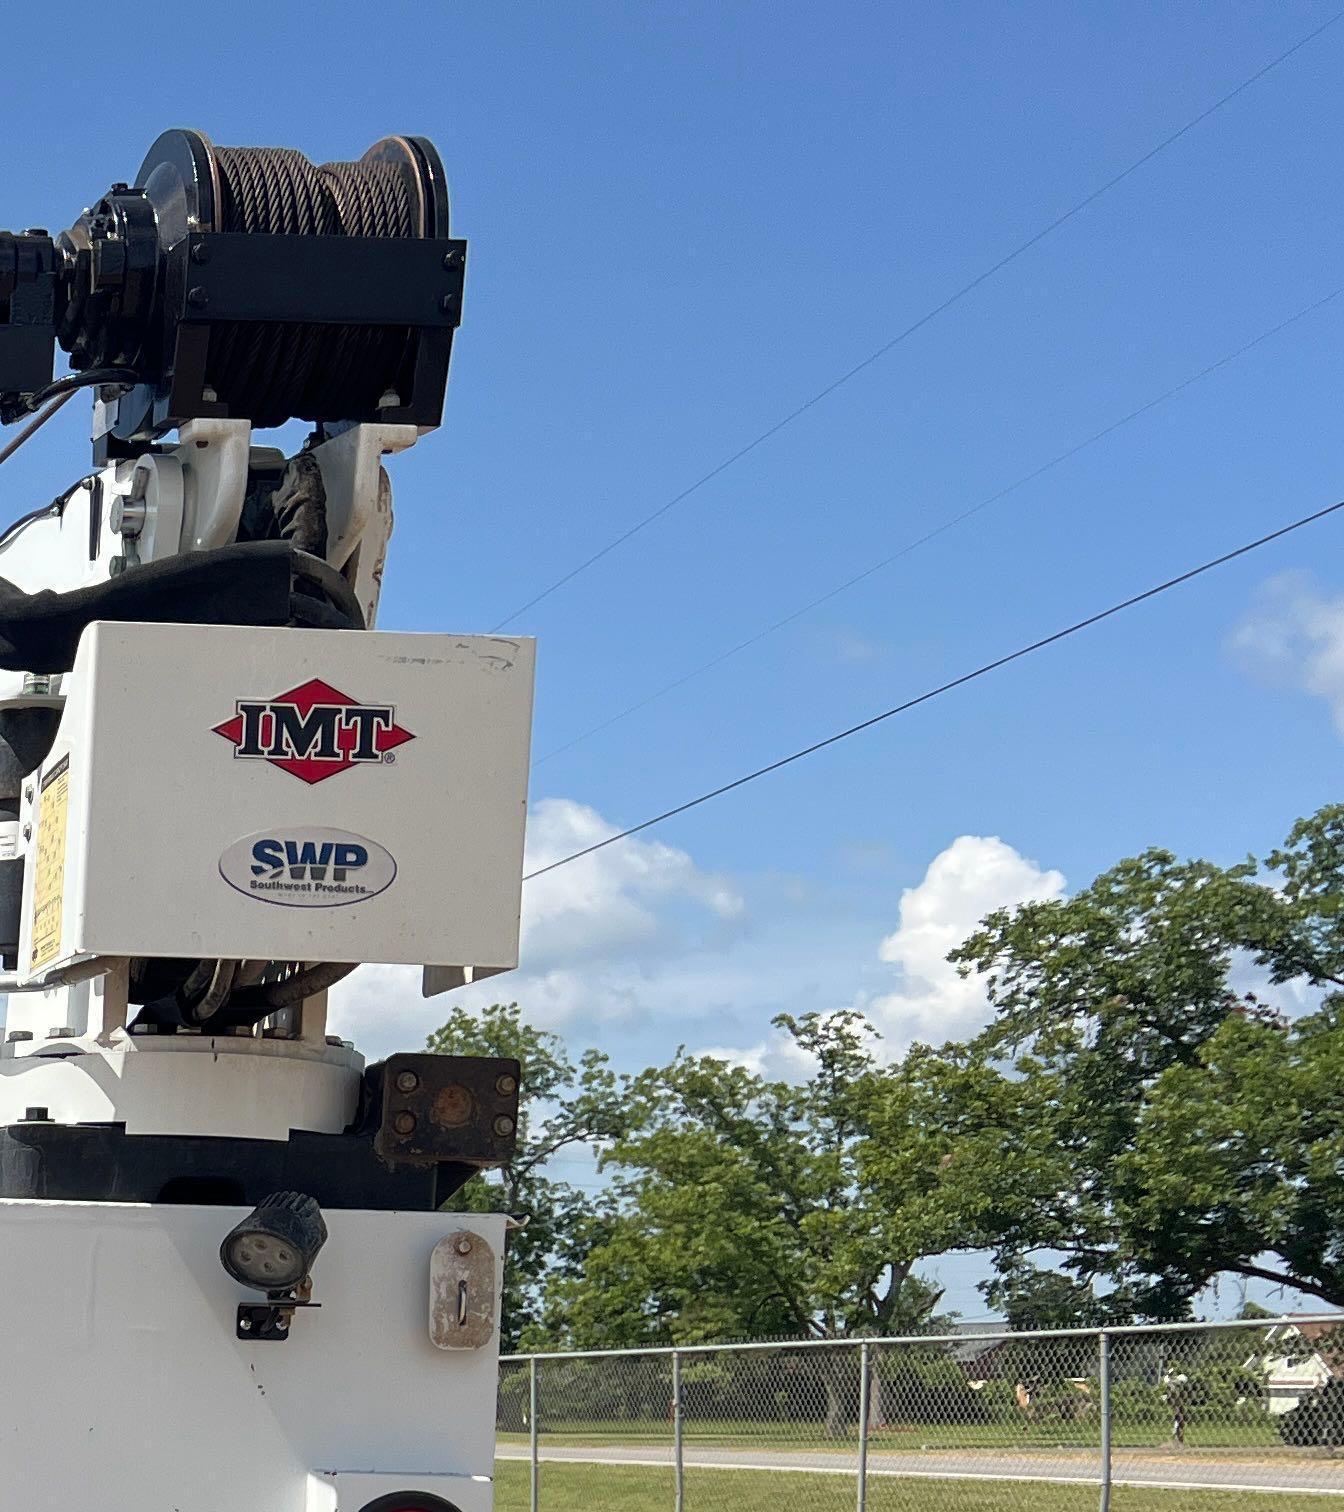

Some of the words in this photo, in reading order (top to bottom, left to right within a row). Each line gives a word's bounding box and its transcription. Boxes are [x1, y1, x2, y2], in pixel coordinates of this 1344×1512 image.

[234, 700, 395, 764] IMT
[250, 838, 368, 882] SWP
[249, 879, 312, 893] Southwest
[314, 882, 367, 894] Products
